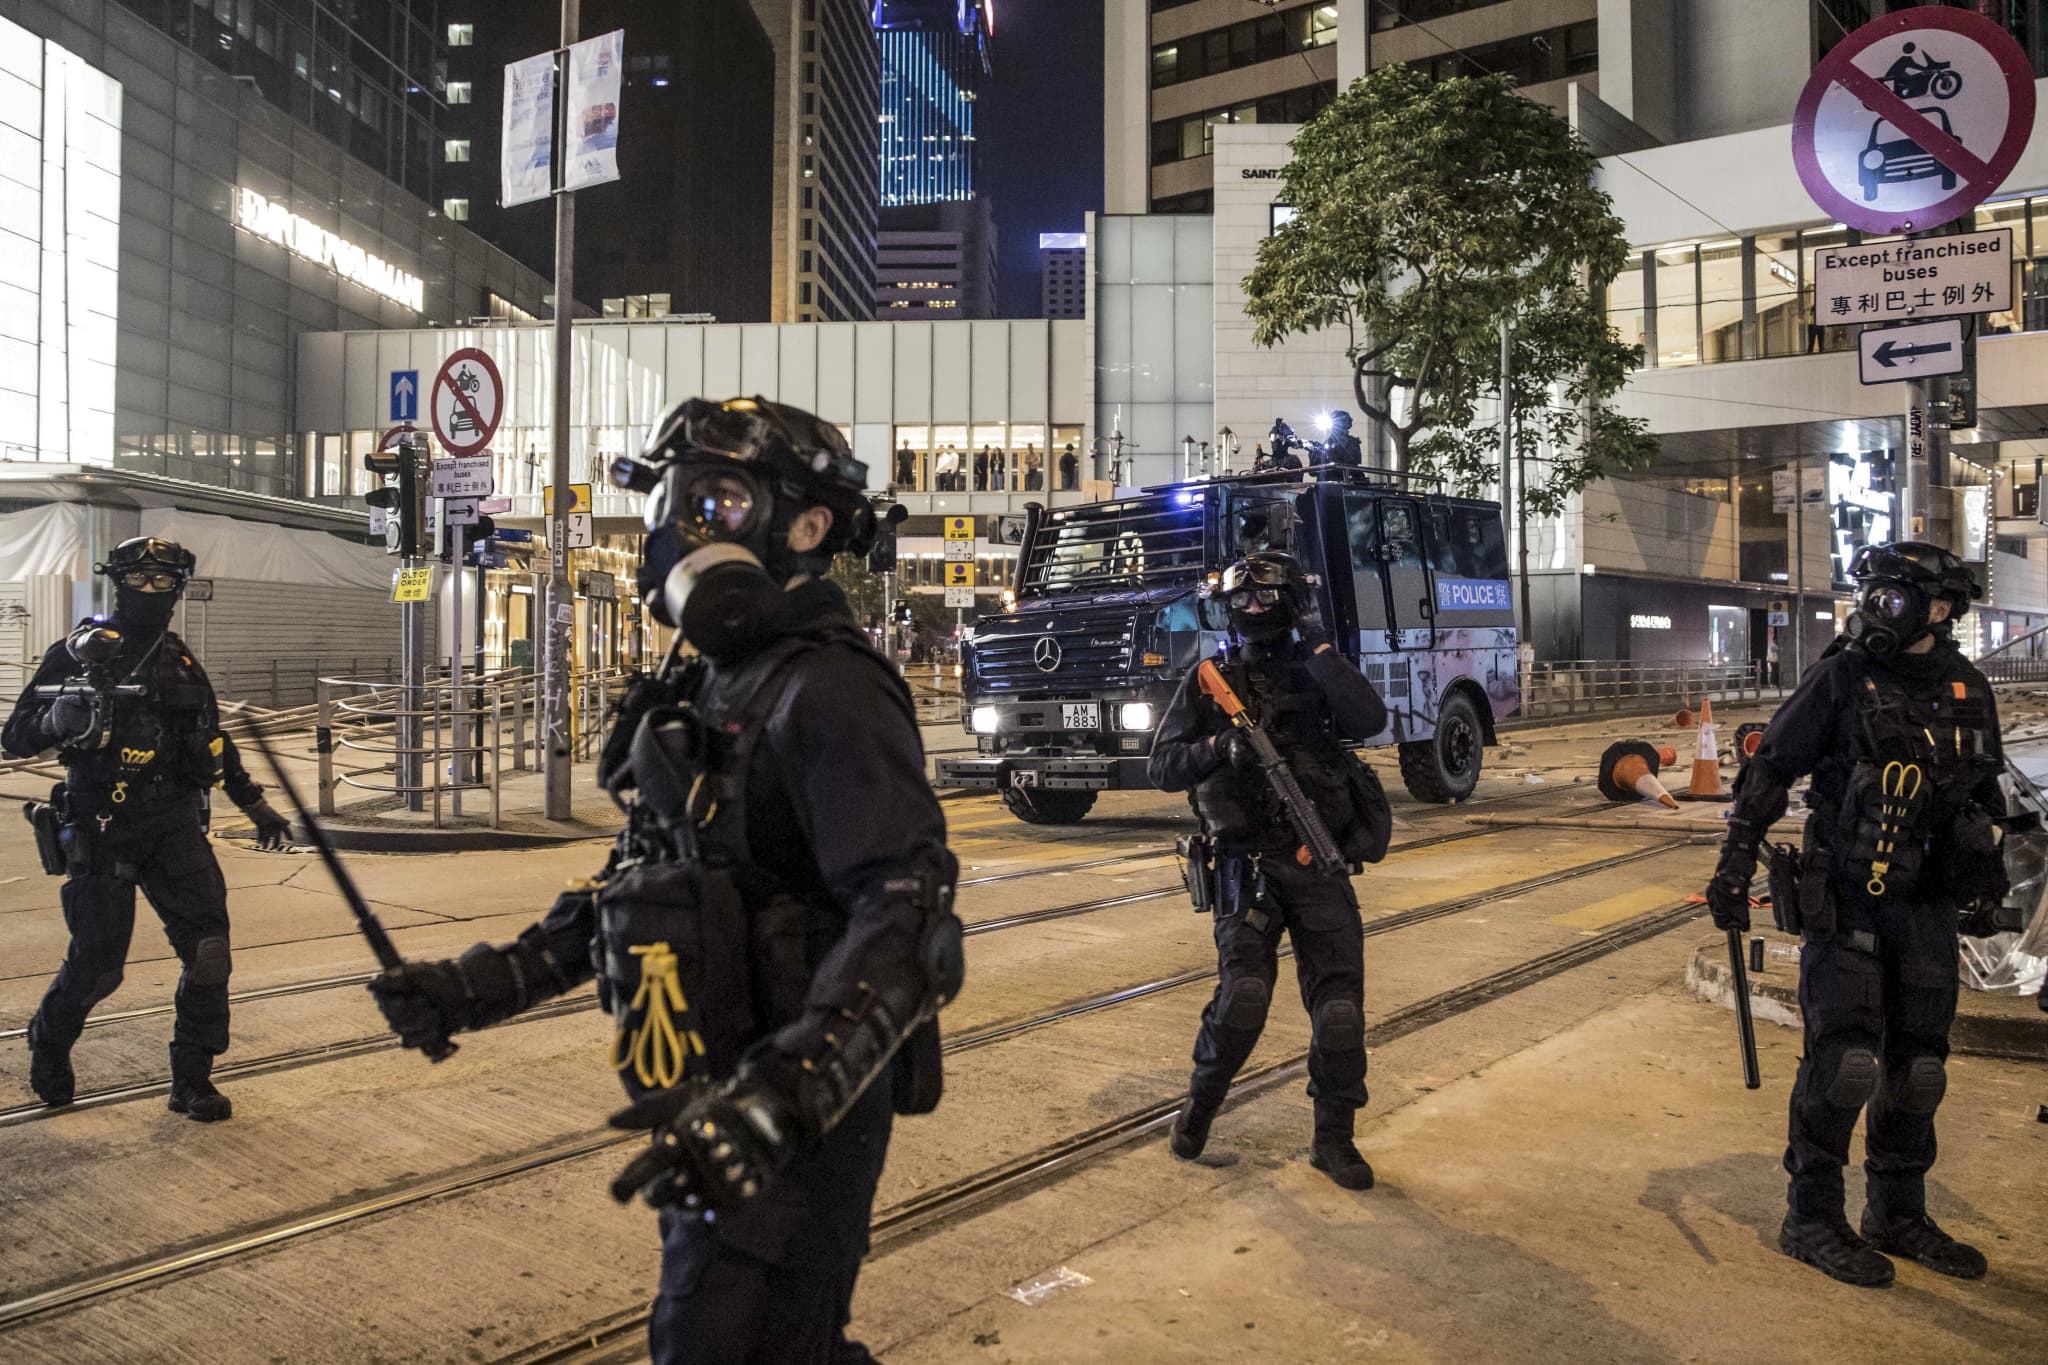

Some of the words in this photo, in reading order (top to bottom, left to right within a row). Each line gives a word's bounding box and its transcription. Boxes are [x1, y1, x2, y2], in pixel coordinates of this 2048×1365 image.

[1242, 169, 1278, 179] SAINT
[1826, 249, 1890, 269] Except
[1895, 237, 2001, 263] franchised
[1883, 266, 1938, 282] buses
[1830, 281, 1995, 316] 專利巴士例外
[436, 461, 457, 470] Except
[575, 516, 583, 527] 7
[576, 533, 584, 545] 7
[402, 571, 418, 579] OUT
[419, 570, 429, 578] OF
[400, 579, 427, 587] ORDER
[1452, 585, 1494, 604] POLICE
[1495, 583, 1506, 606] 察
[1072, 704, 1088, 716] AM
[1065, 716, 1097, 728] 7883
